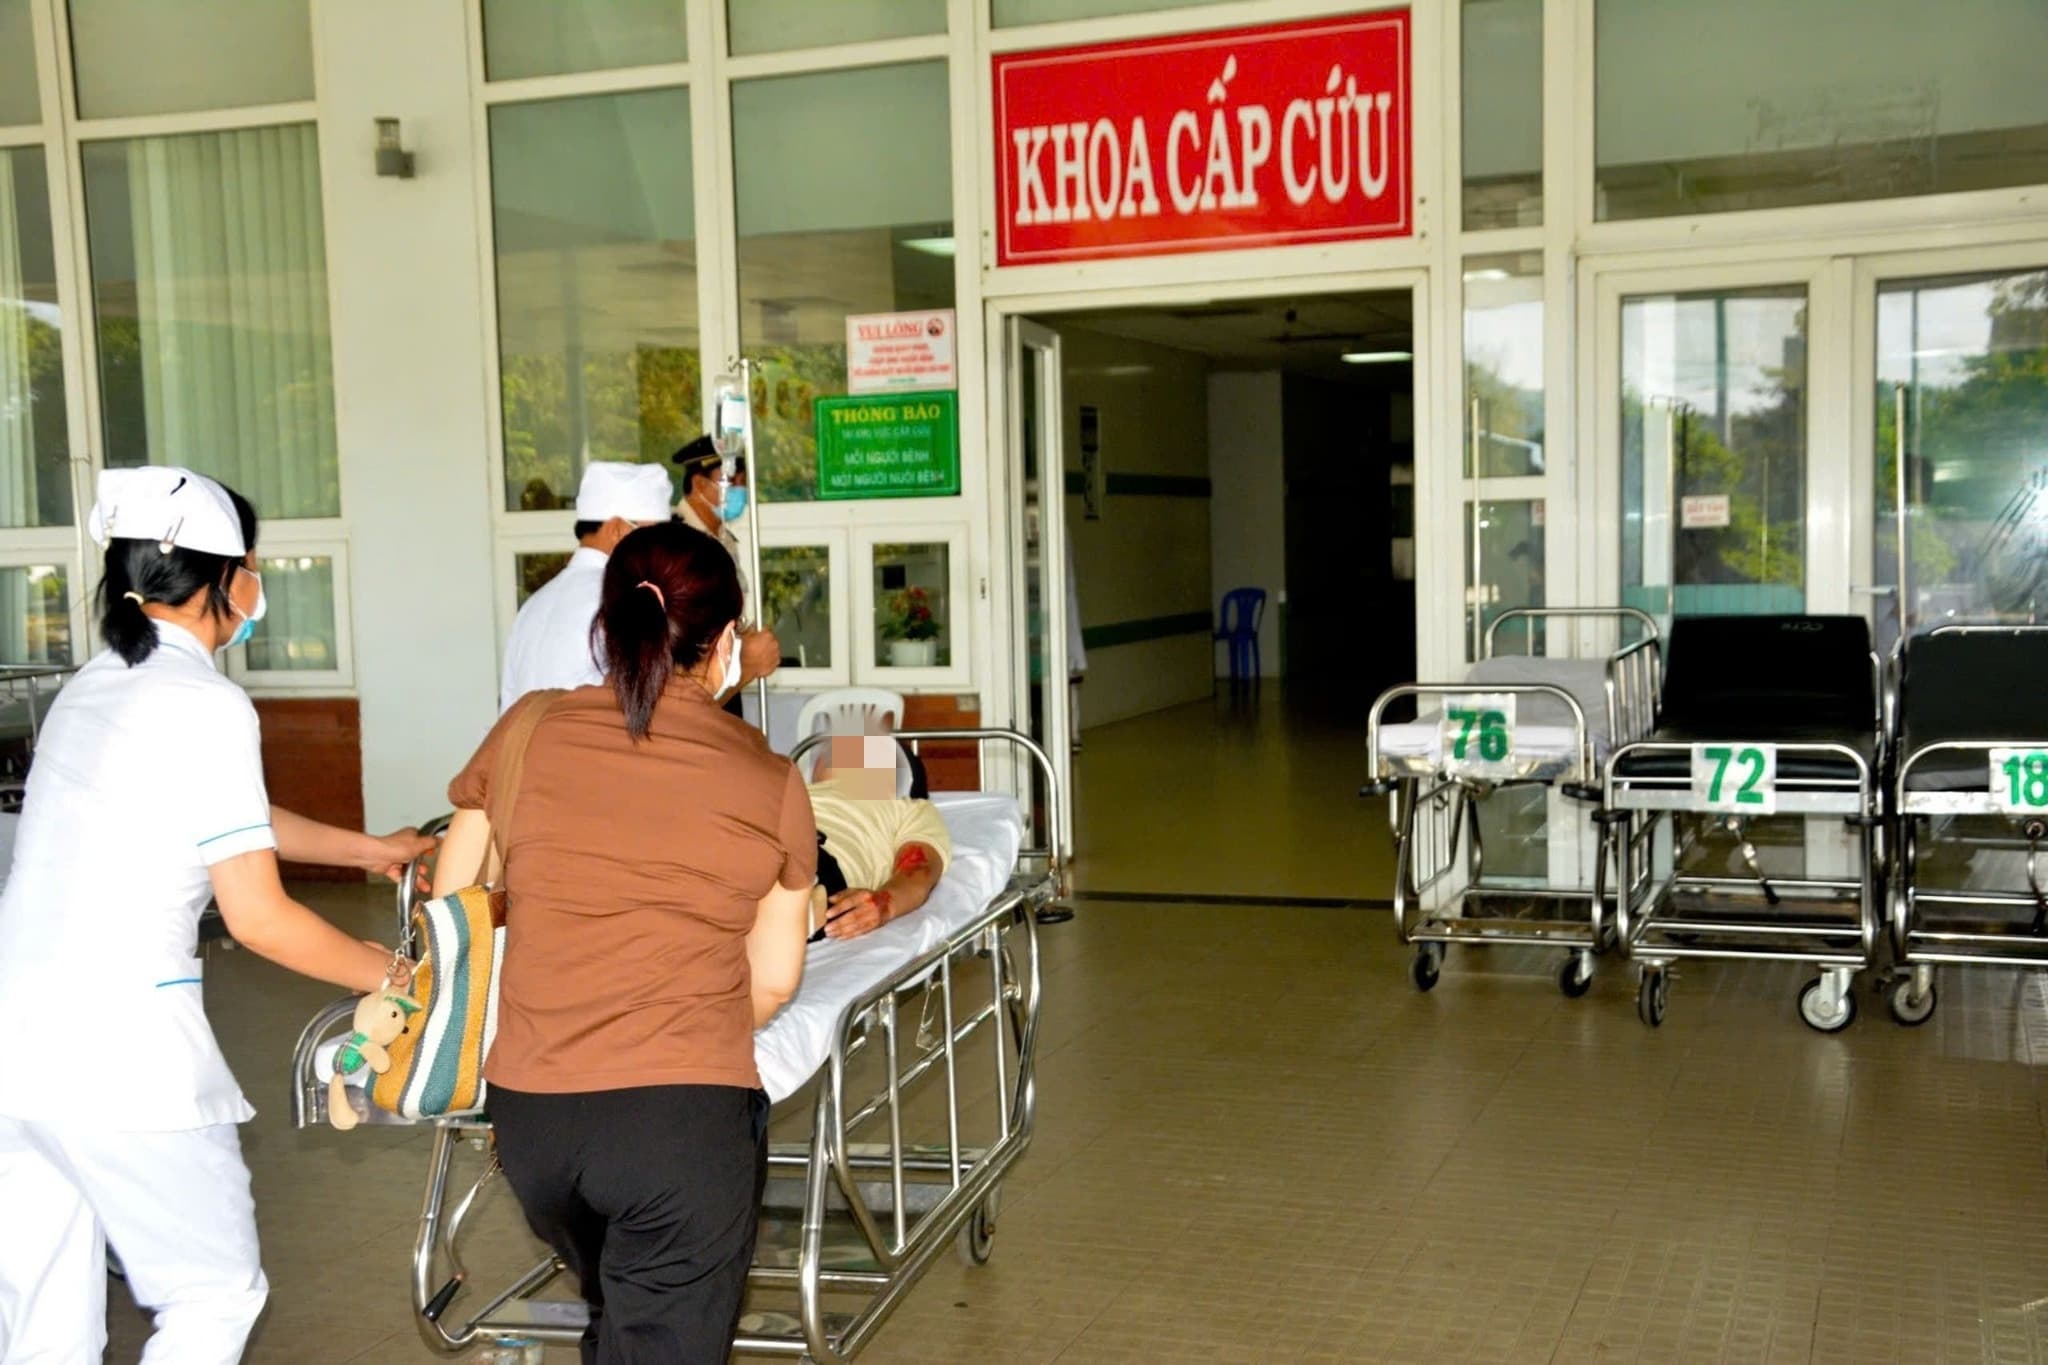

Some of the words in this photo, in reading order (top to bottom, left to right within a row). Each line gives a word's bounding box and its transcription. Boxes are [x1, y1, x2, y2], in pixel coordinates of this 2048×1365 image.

[1012, 115, 1160, 225] KHOA
[1166, 54, 1273, 215] CẤP
[1280, 63, 1392, 206] CỨU
[1447, 702, 1508, 761] 76
[1704, 748, 1765, 803] 72
[2003, 751, 2048, 806] 18
